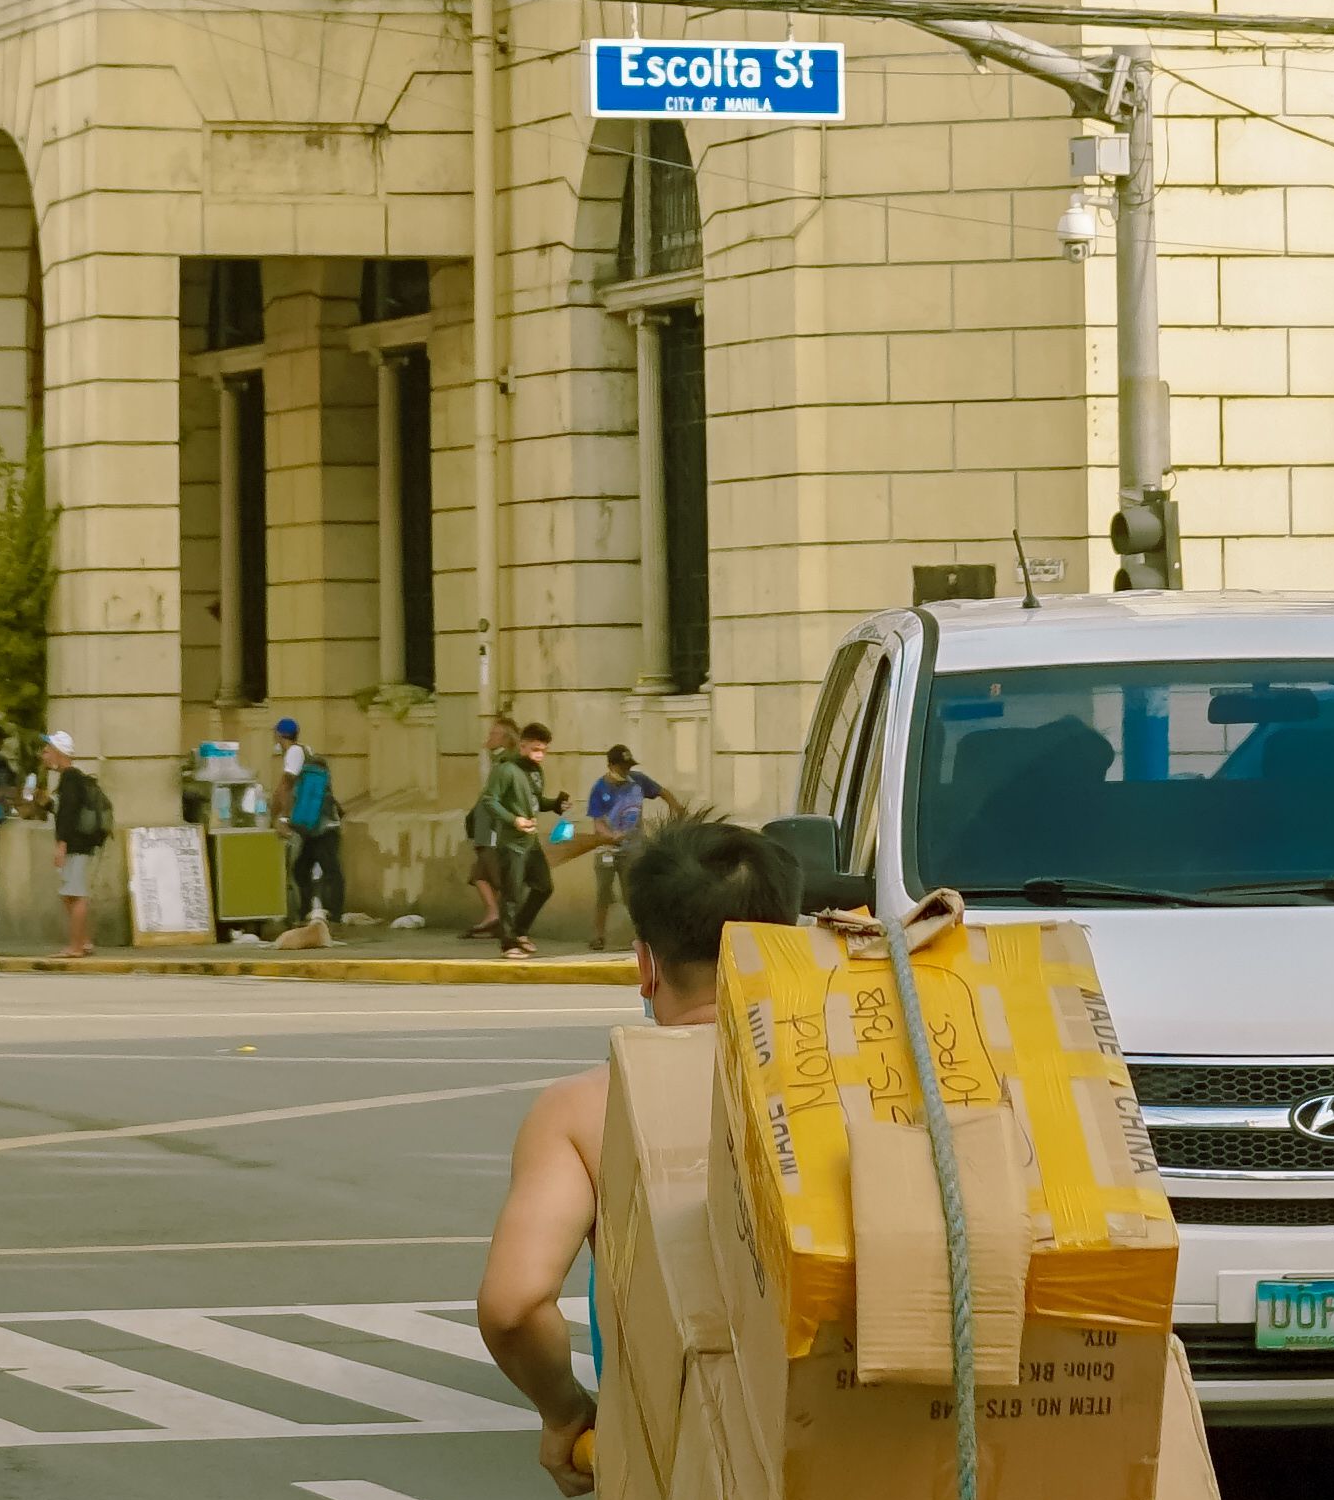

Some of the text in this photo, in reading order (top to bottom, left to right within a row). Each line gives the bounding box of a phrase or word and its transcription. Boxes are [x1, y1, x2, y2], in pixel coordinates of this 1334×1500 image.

[620, 46, 814, 89] Escolta St
[665, 96, 772, 112] CITY OF MANILA
[1079, 986, 1120, 1057] MADE
[1113, 1095, 1159, 1175] CHINA
[1068, 1396, 1112, 1416] ITEM
